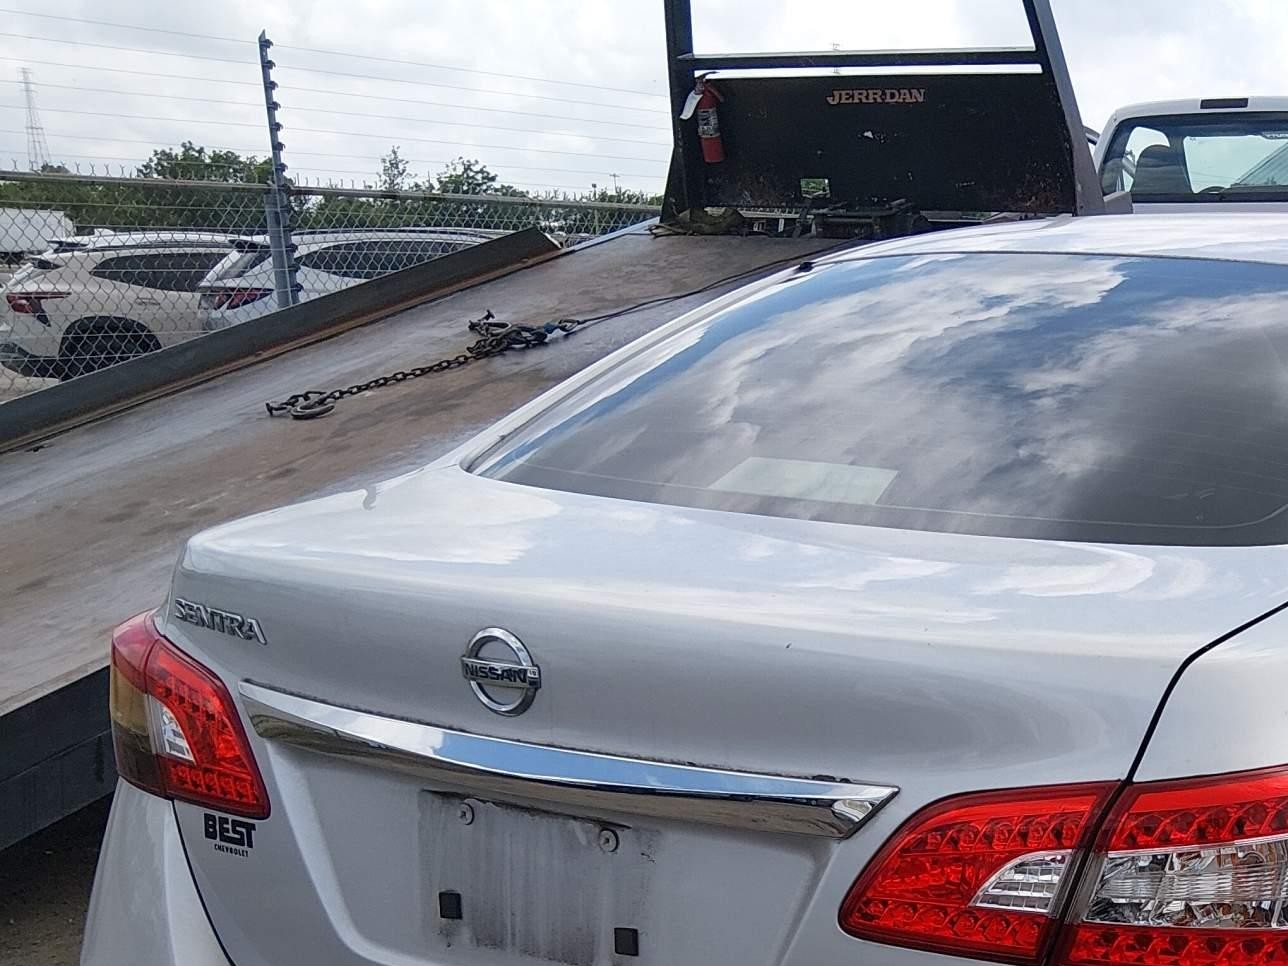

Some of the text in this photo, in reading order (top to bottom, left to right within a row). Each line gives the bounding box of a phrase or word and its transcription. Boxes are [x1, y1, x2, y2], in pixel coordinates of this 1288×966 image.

[174, 597, 268, 644] SENTRA
[463, 662, 529, 683] NISSAN
[203, 812, 257, 849] BEST
[214, 843, 249, 858] CHEVROLET
